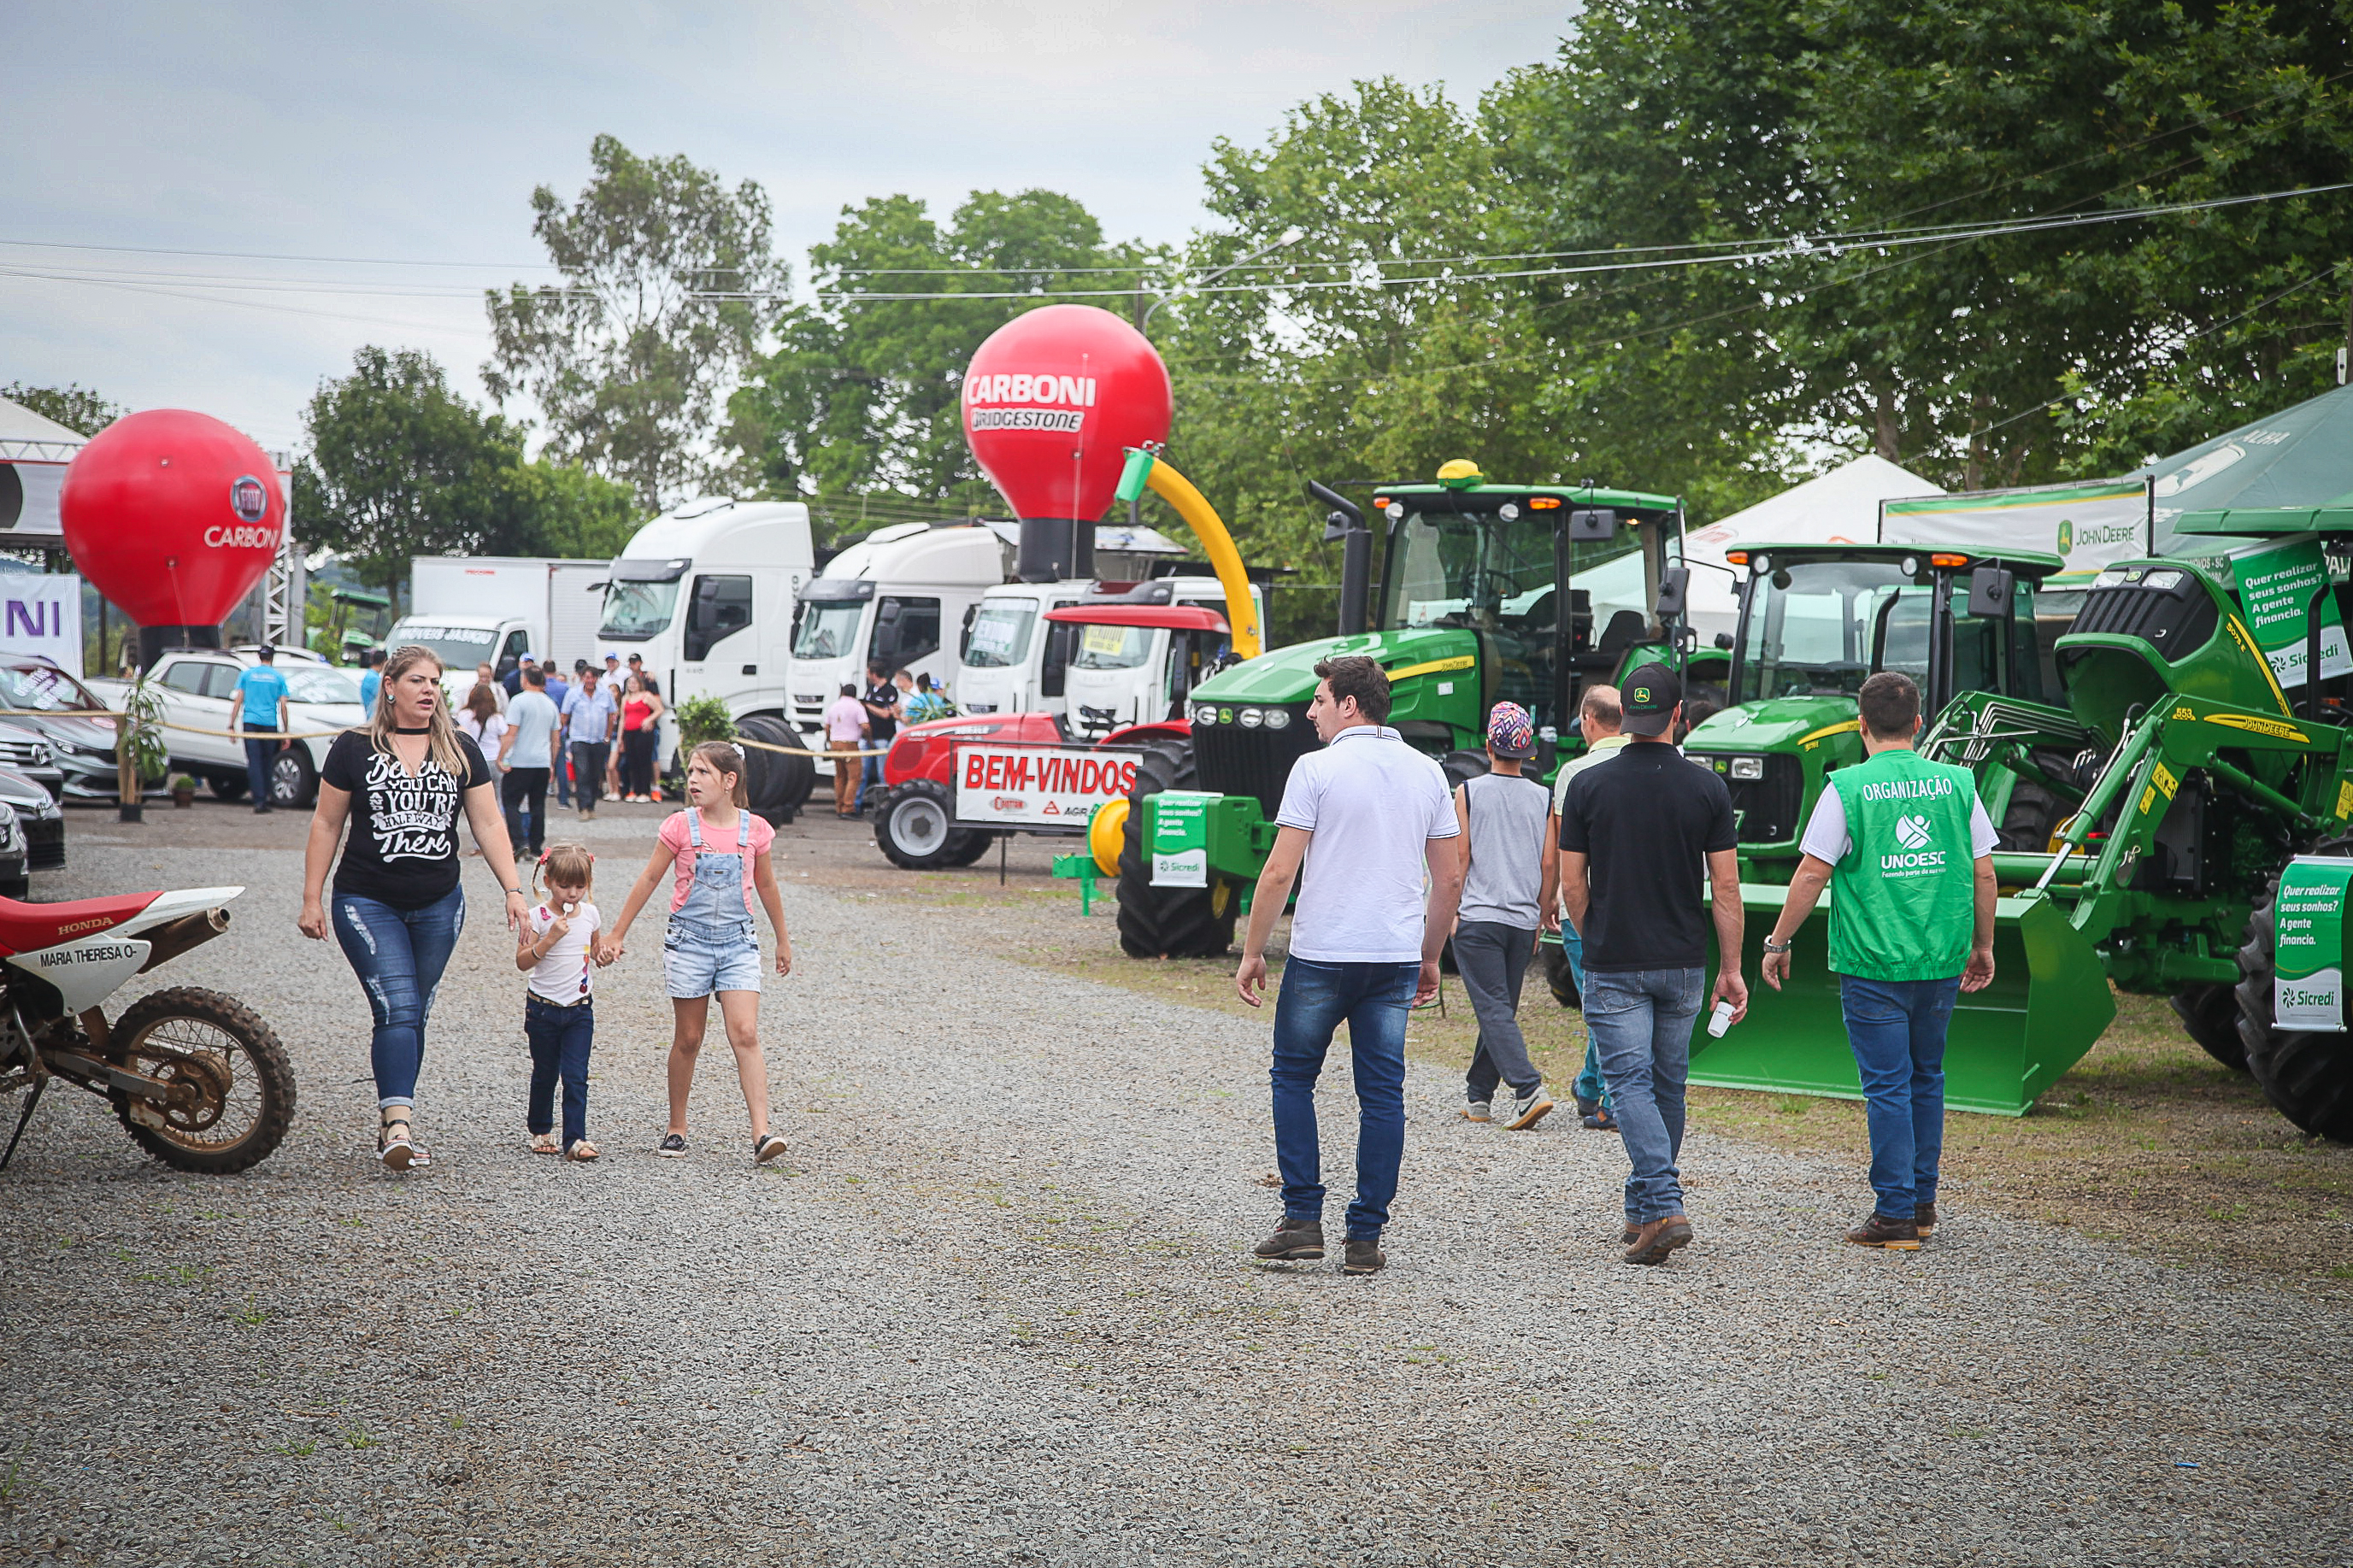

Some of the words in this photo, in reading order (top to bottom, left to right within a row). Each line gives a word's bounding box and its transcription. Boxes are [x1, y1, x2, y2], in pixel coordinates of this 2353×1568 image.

[968, 374, 1097, 407] CARBONI
[974, 411, 1081, 429] BRIDGESTONE
[2076, 527, 2102, 546] JOHN
[2103, 526, 2135, 543] DEERE
[2245, 573, 2273, 590] Quer
[2274, 562, 2318, 581] realizar
[2248, 587, 2275, 602] seus
[2276, 573, 2323, 594] sonhos?
[2252, 603, 2261, 614] A
[2262, 596, 2294, 614] gente
[2255, 608, 2304, 629] financia.
[2289, 643, 2338, 667] Sicedi
[2175, 707, 2193, 719] 553
[2244, 719, 2266, 731] JOHN
[2264, 722, 2291, 737] DEERE
[388, 778, 423, 791] YOU
[426, 772, 458, 792] CAN
[965, 755, 1137, 796] BEM-VINDOS
[1862, 775, 1953, 802] ORGANIZAÇÃO
[385, 790, 458, 815] YOU'RE
[373, 827, 451, 862] There
[1171, 861, 1200, 872] Sicredi
[1881, 851, 1946, 869] UNOESC
[2283, 884, 2305, 900] Quer
[2304, 884, 2341, 896] realizar
[2279, 903, 2301, 913] seus
[2301, 900, 2339, 913] sonhos?
[57, 917, 115, 937] HONDA
[2279, 917, 2287, 929] A
[2286, 918, 2312, 931] gente
[2279, 933, 2316, 948] financia.
[40, 951, 74, 967] MARIA
[74, 946, 123, 963] THERESA
[2297, 990, 2334, 1006] Sicredi
